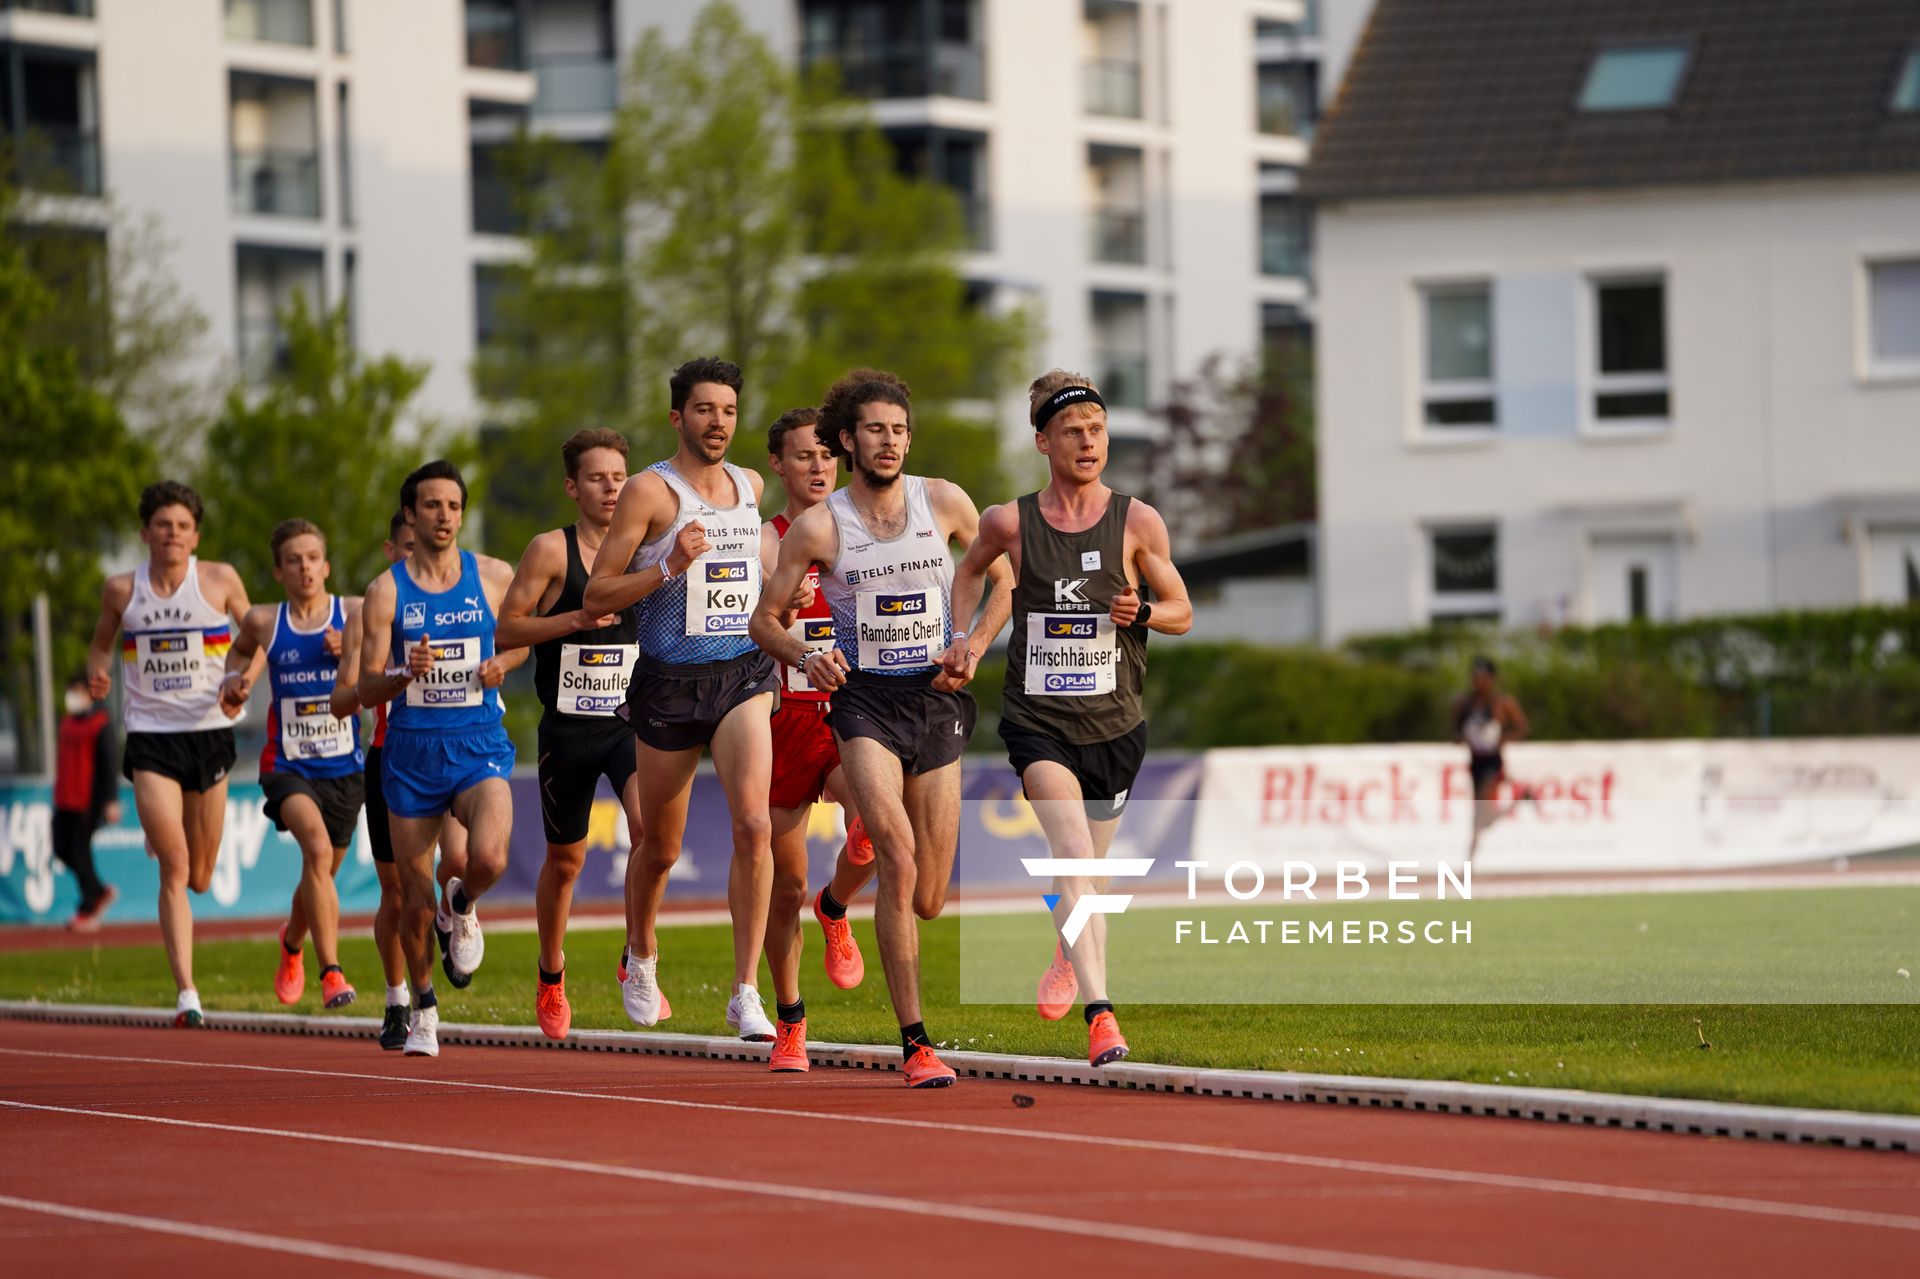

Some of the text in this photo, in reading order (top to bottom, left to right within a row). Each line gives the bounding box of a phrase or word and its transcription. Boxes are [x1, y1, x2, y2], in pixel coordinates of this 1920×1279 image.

[730, 567, 745, 578] GLS
[861, 557, 943, 579] TELIS FINANZ
[707, 589, 749, 612] Key
[903, 599, 922, 611] GLS
[1055, 603, 1090, 611] KIEFER
[435, 610, 483, 626] SCHOTT
[724, 616, 748, 625] PLAN
[861, 622, 910, 643] Ramdane
[912, 617, 942, 640] Cherif
[1071, 624, 1093, 635] GLS
[443, 647, 461, 659] GLS
[602, 653, 620, 664] GLS
[898, 648, 926, 658] PLAN
[1029, 644, 1112, 667] Hirschhäuser
[144, 657, 199, 674] Abele
[280, 671, 317, 684] BECK
[562, 671, 630, 691] Schaufle
[1066, 676, 1095, 685] PLAN
[440, 690, 465, 699] PLAN
[594, 699, 619, 707] PLAN
[287, 719, 347, 737] Ulbrich
[1261, 764, 1419, 824] Black
